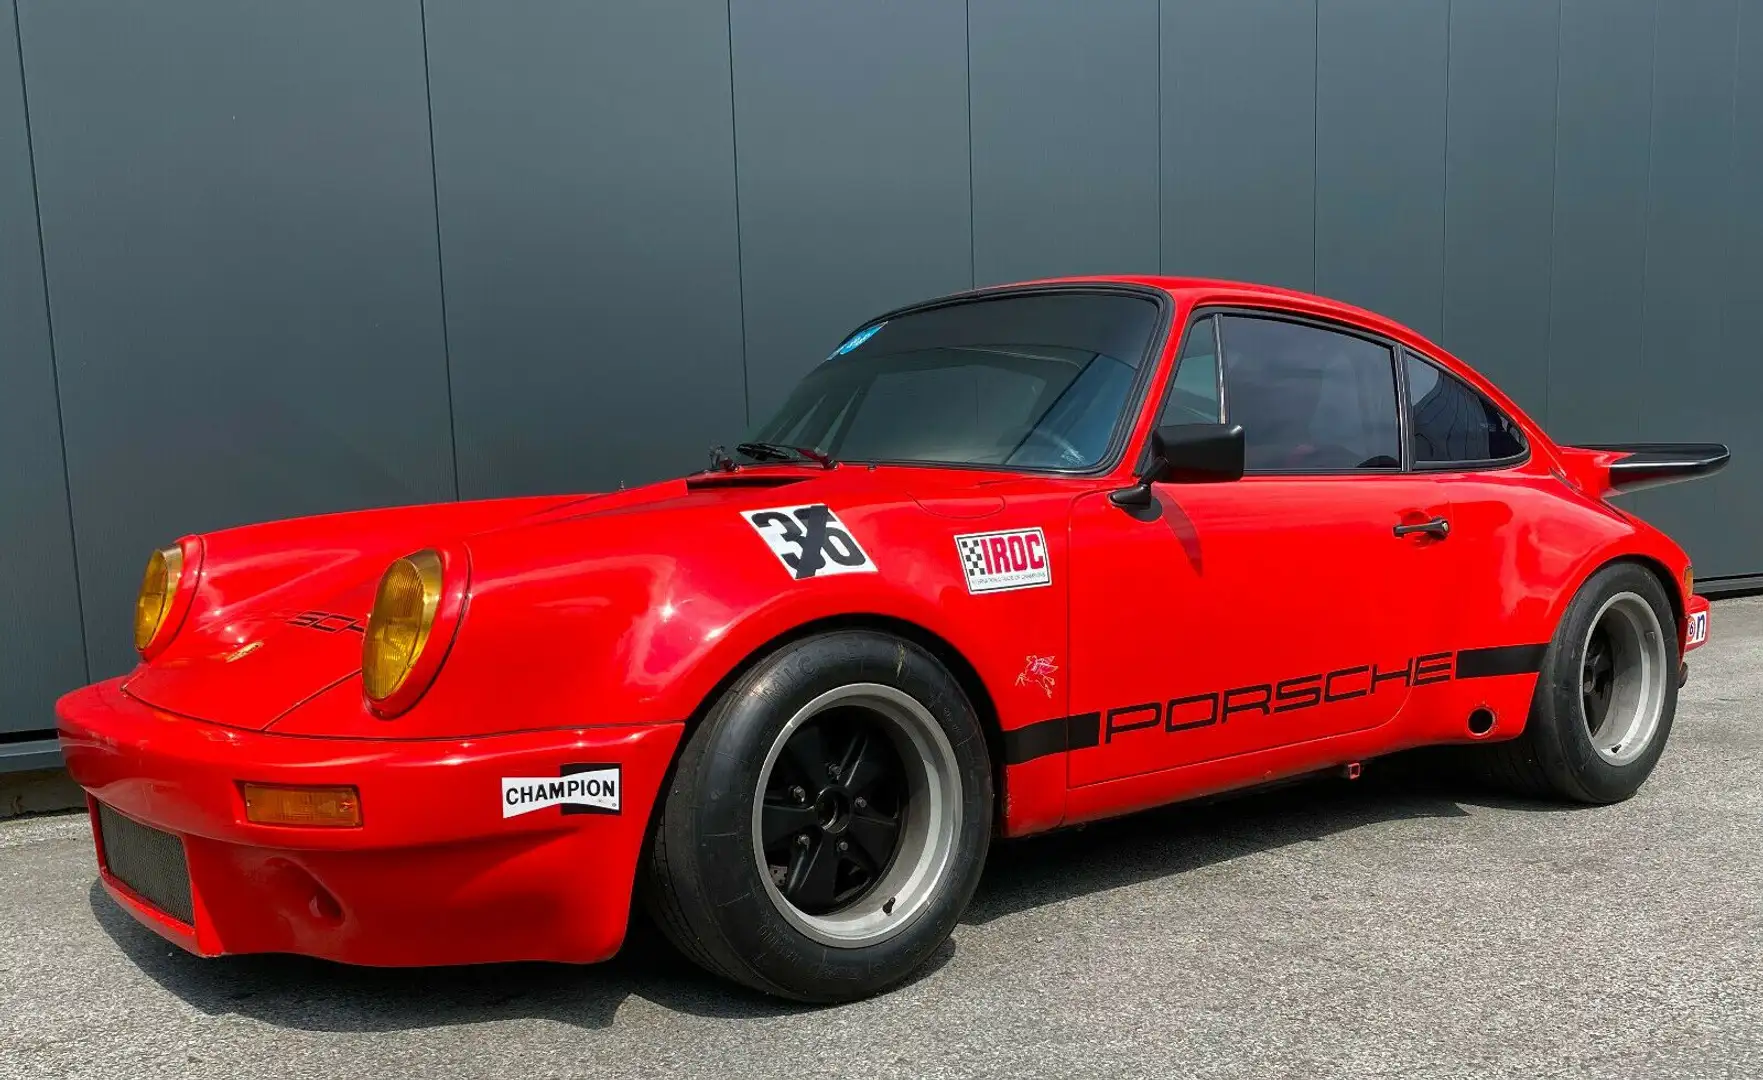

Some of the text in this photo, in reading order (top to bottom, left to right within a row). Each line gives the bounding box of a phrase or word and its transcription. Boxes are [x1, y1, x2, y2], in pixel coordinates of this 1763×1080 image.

[980, 534, 1044, 575] IROC
[1105, 651, 1453, 744] PORSCHE
[505, 779, 615, 806] CHAMPION
